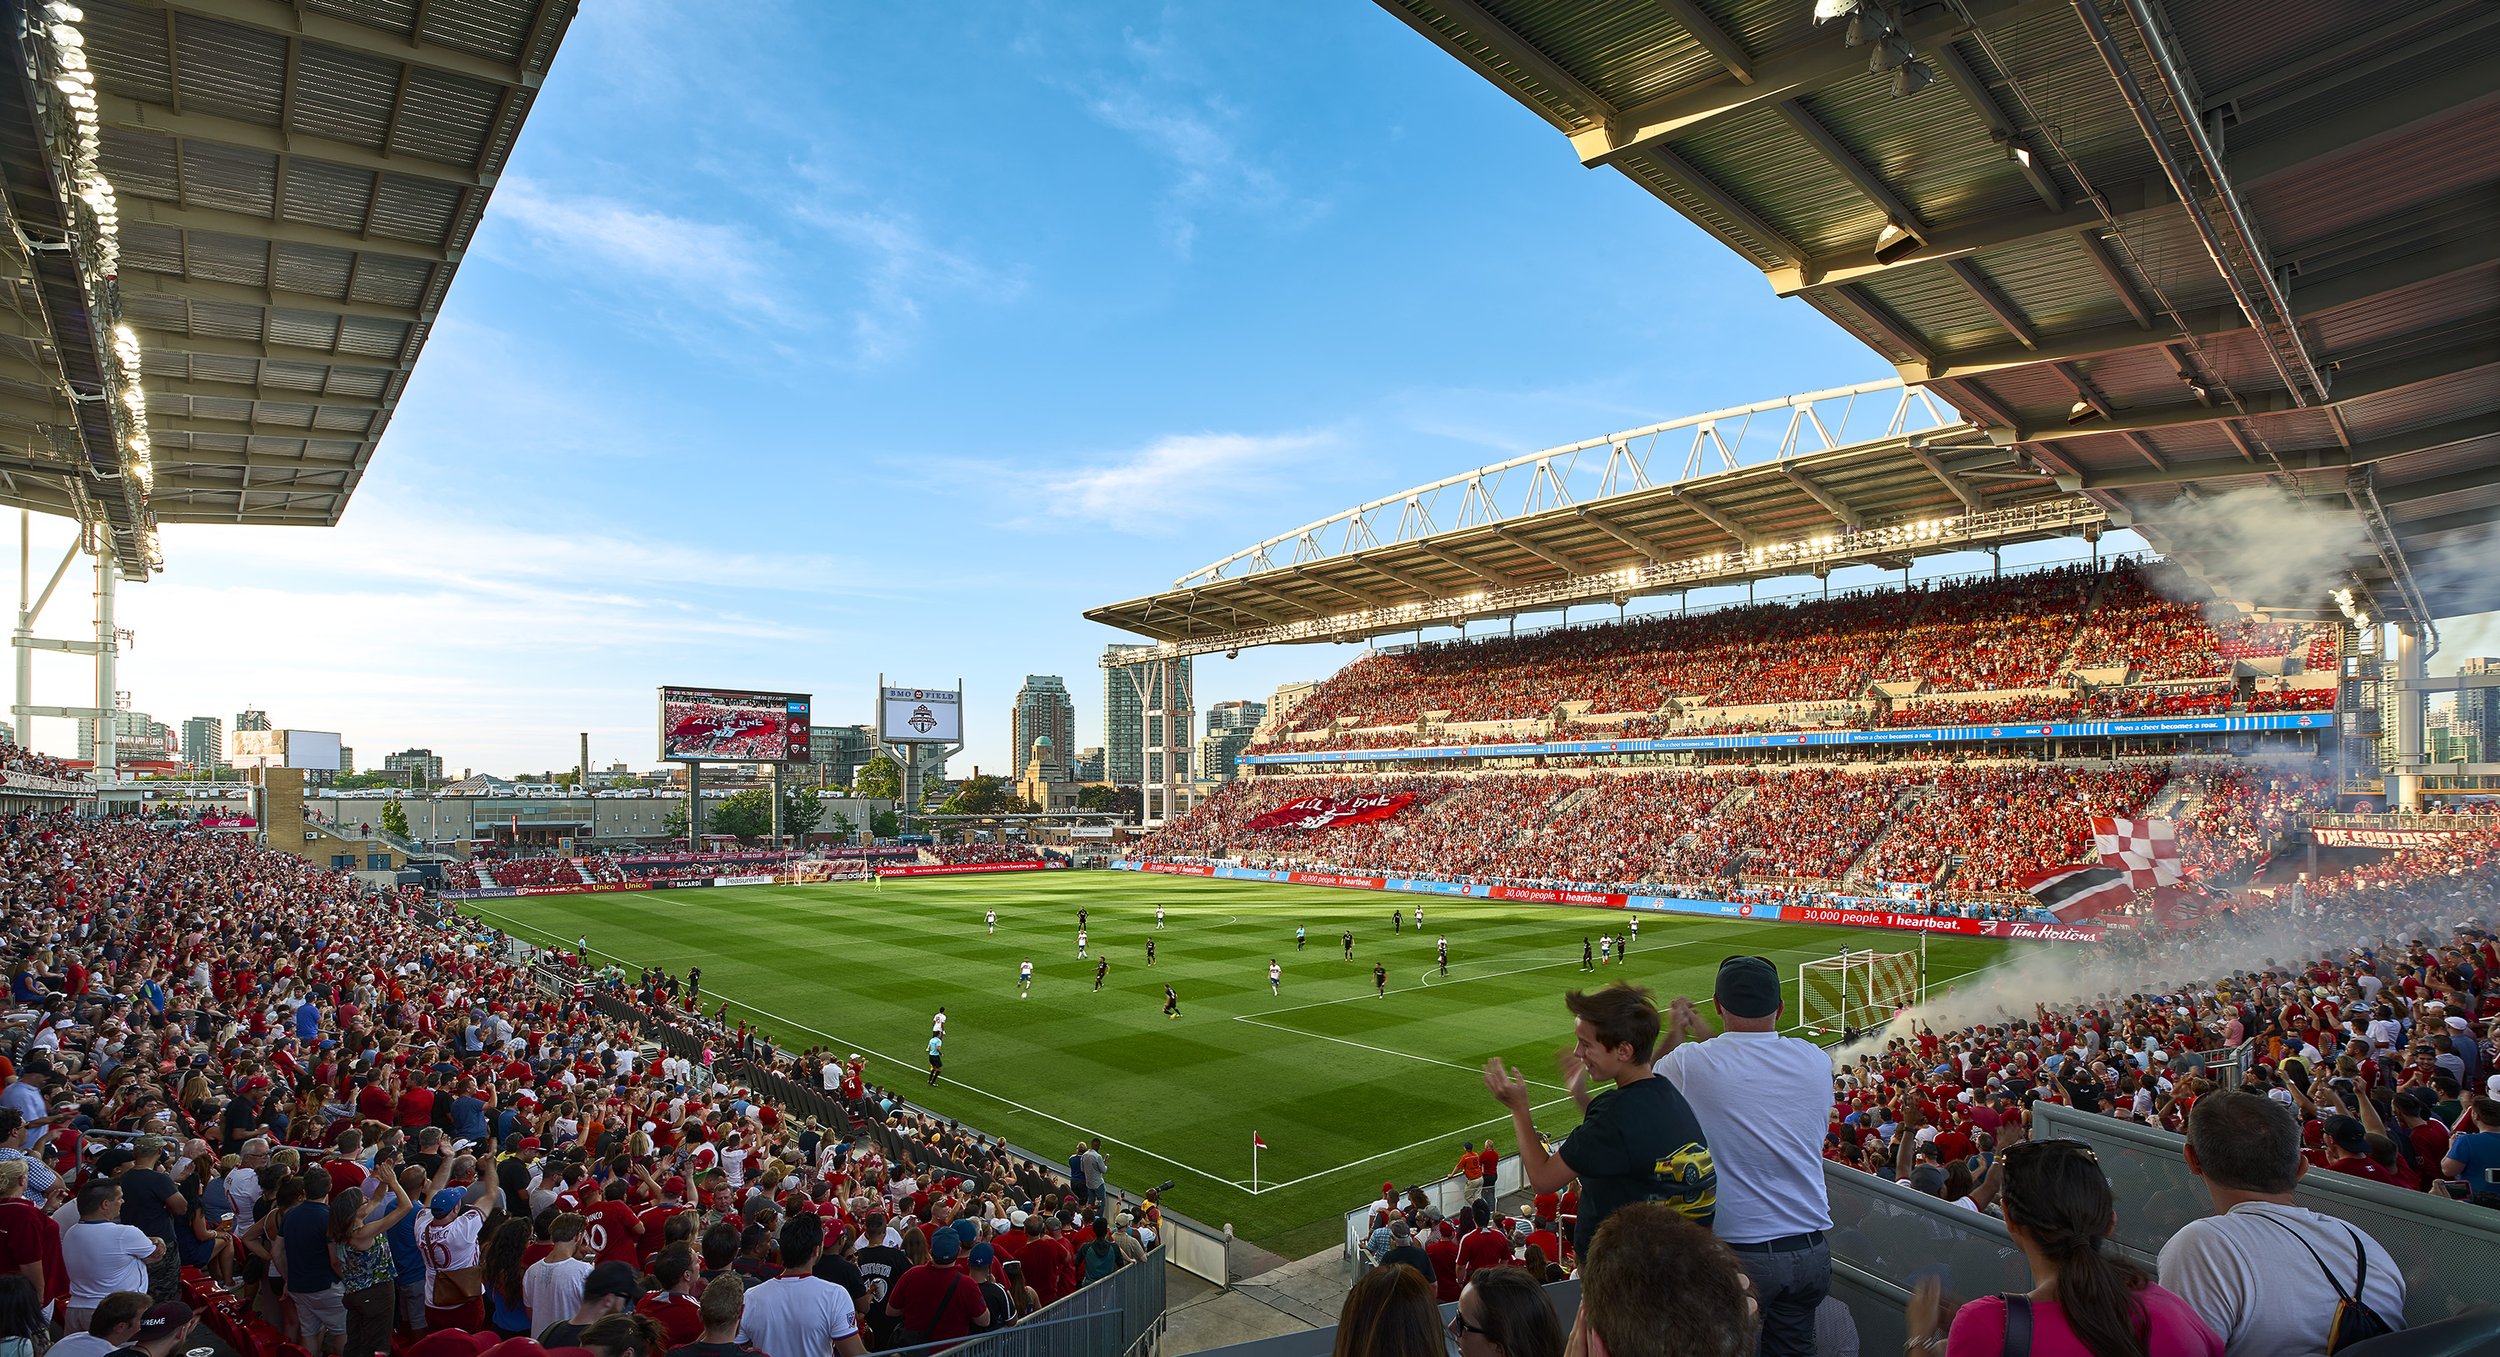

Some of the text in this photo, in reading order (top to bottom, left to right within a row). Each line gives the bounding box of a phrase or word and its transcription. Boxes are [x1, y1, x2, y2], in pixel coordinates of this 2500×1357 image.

[692, 718, 718, 726] ALL
[1290, 798, 1323, 810] ALL
[1352, 796, 1390, 808] ONE
[2314, 829, 2351, 845] THE
[2351, 830, 2452, 847] FORTRESS
[848, 870, 873, 880] adidas
[1343, 878, 1372, 886] heartbeat.
[1504, 889, 1529, 898] 30,000
[1530, 891, 1556, 900] people.
[1566, 893, 1607, 904] heartbeat.
[1804, 910, 1960, 930] 30,000 people. 1 heartbeat.
[2010, 924, 2035, 937] Tim
[848, 1080, 855, 1089] 4
[419, 1242, 451, 1269] 10
